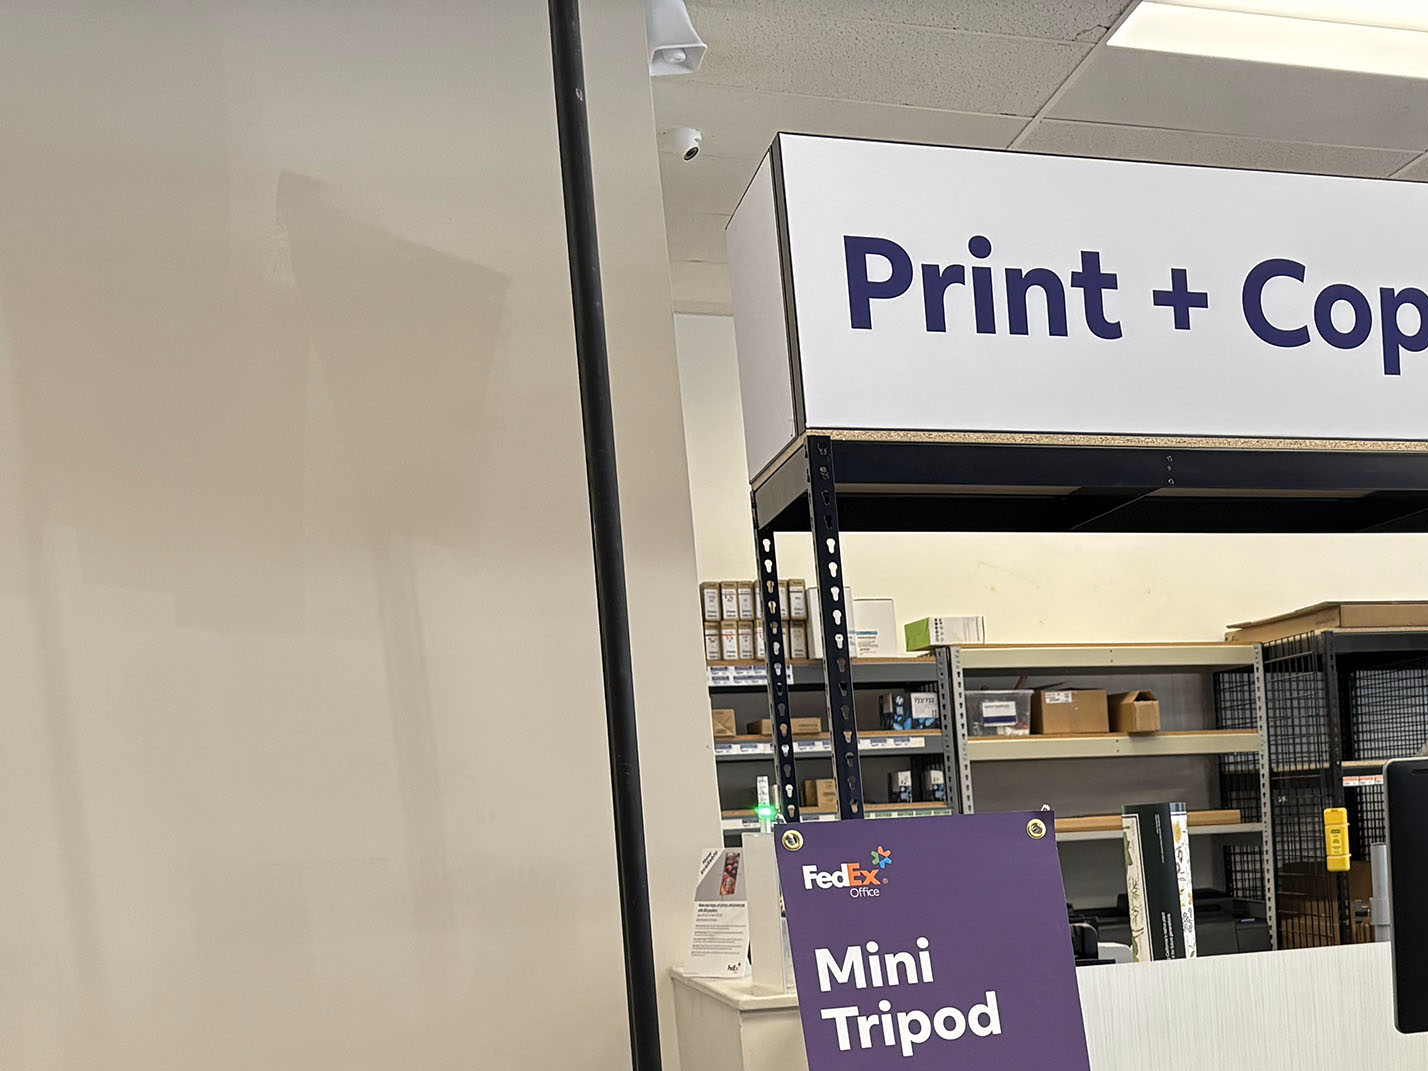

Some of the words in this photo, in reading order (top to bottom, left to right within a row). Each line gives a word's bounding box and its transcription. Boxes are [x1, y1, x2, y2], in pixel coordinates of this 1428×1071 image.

[842, 235, 1122, 341] Print
[1153, 269, 1208, 331] +
[803, 862, 881, 891] FedEx
[849, 885, 880, 898] Office
[815, 936, 934, 993] Mini
[821, 991, 1003, 1057] Tripod
